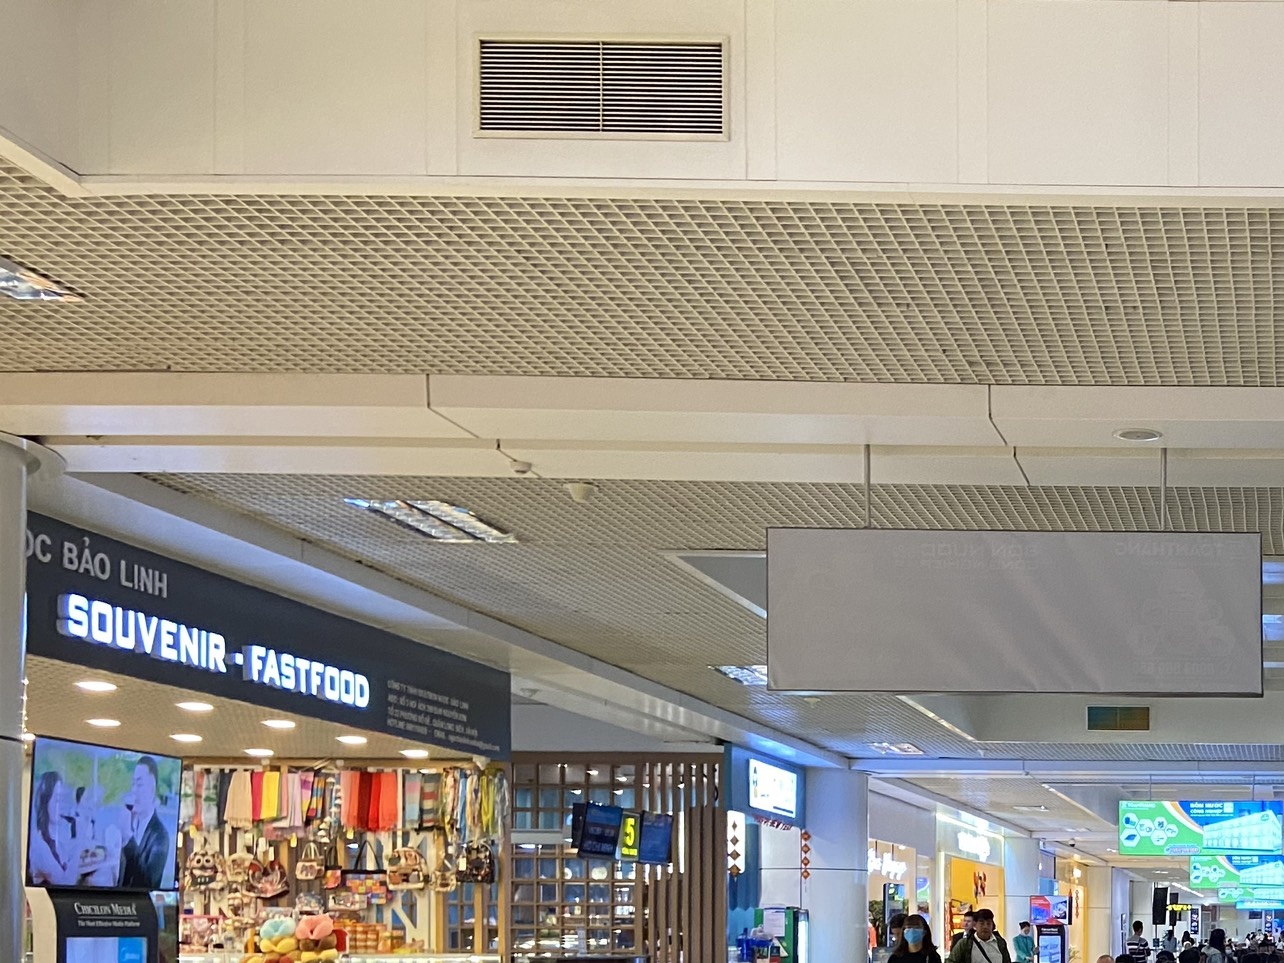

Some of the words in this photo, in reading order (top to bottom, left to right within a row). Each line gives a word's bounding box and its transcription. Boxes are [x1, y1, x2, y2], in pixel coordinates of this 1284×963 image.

[62, 537, 111, 581] BẢO
[119, 560, 168, 598] LINH
[63, 593, 227, 673] SOUVENIR
[247, 644, 370, 708] FASTFOOD
[623, 817, 635, 847] 5
